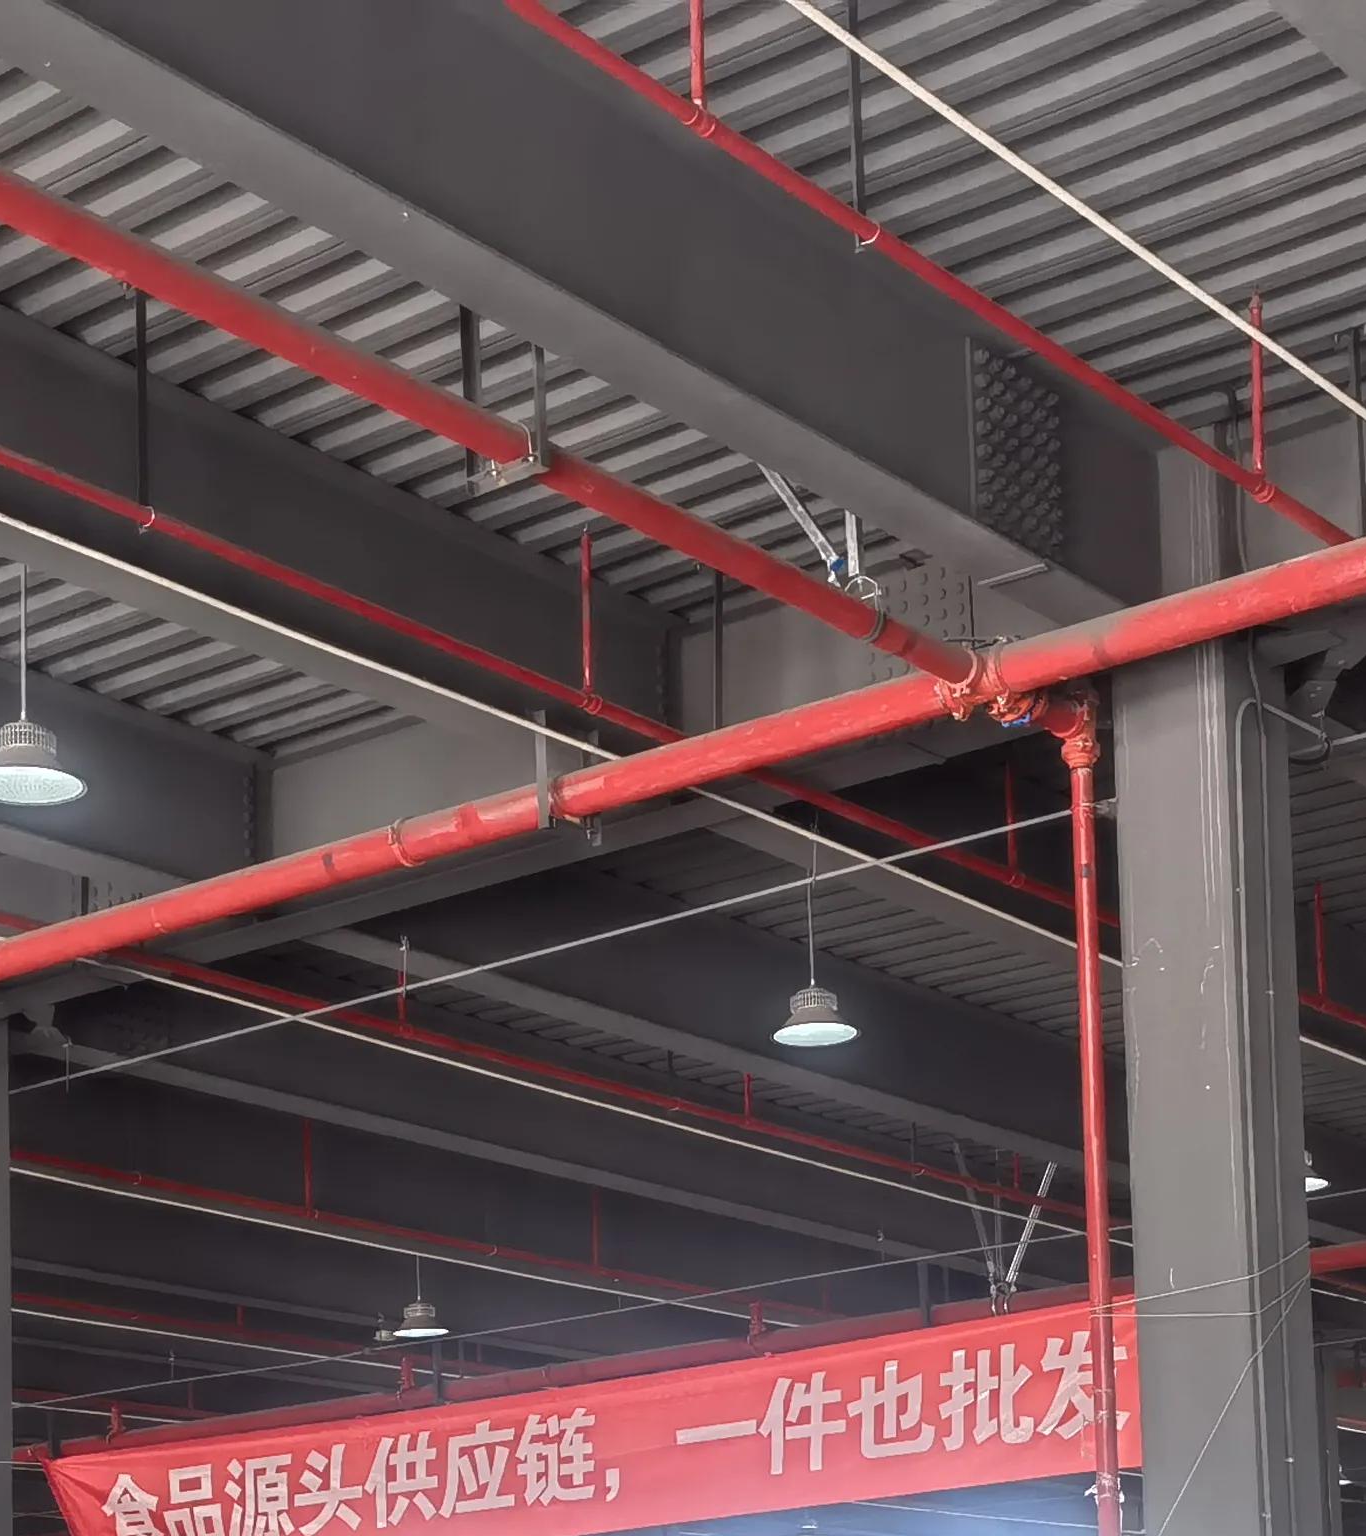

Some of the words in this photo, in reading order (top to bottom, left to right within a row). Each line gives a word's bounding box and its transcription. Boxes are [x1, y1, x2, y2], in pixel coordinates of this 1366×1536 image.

[675, 1333, 1130, 1477] 一件也批发
